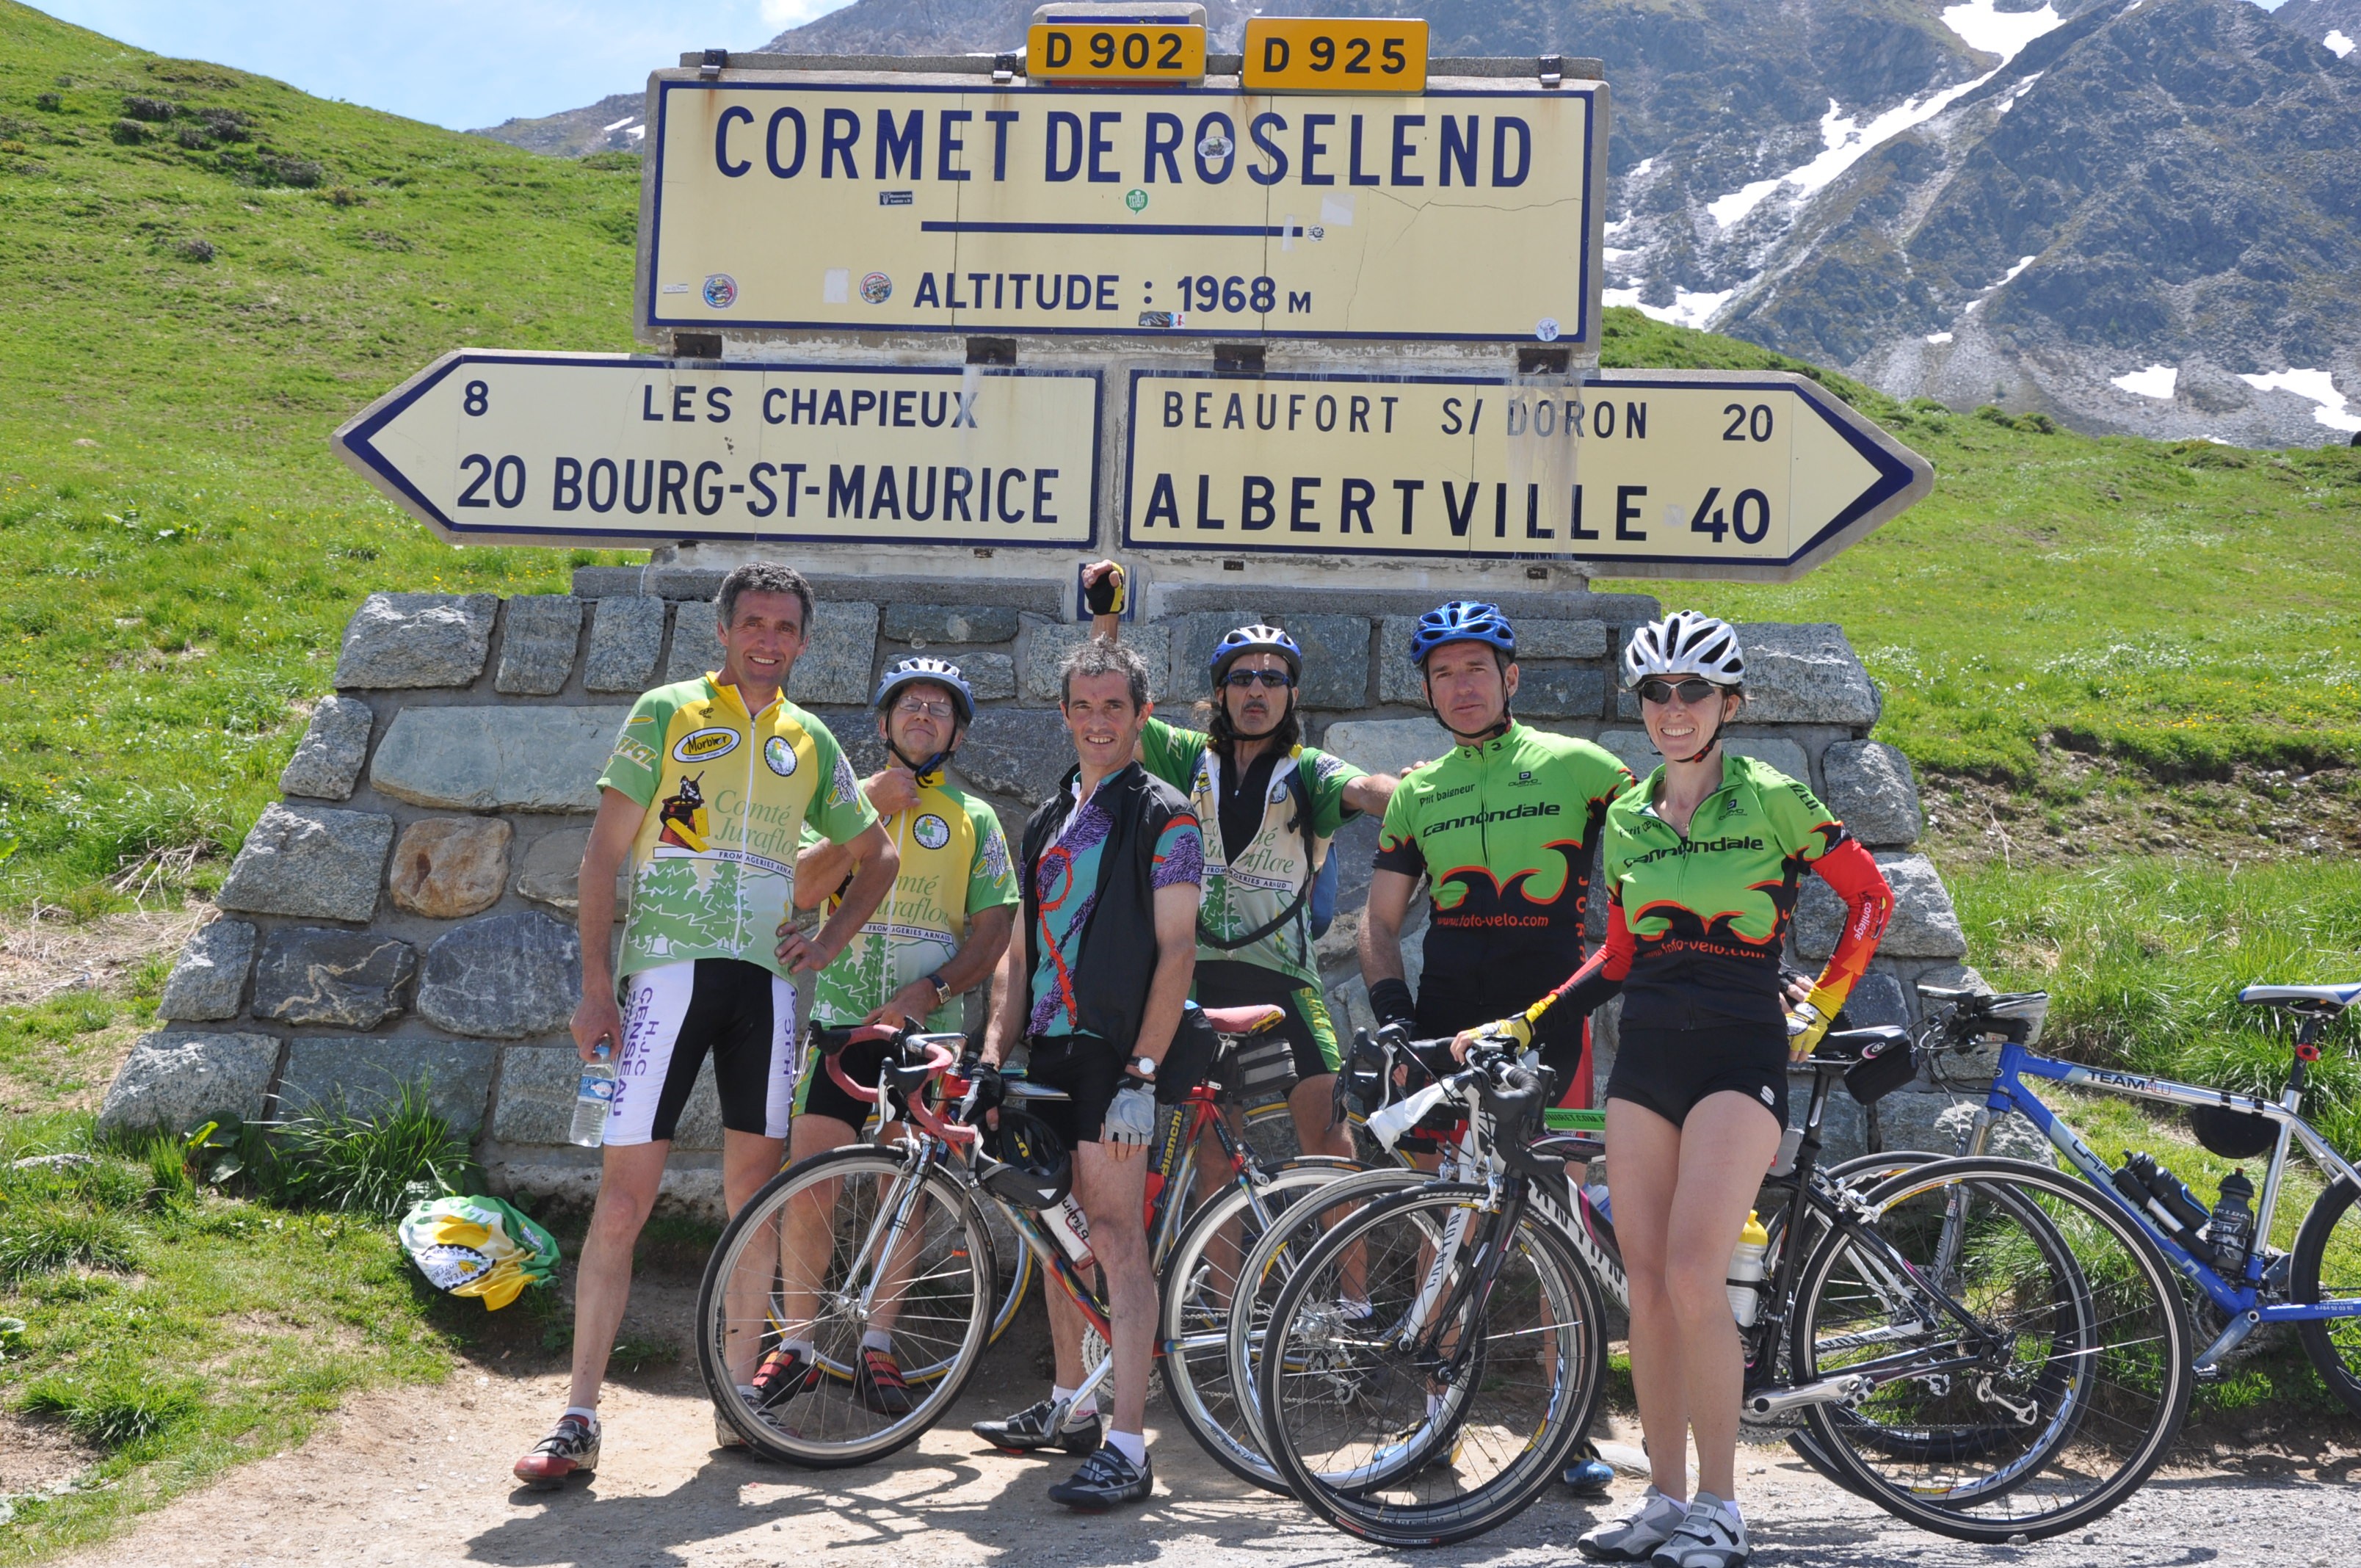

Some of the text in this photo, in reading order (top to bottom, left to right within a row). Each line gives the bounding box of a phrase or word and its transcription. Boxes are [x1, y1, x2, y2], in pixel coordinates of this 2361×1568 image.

[1045, 32, 1183, 69] D 902
[1263, 37, 1406, 75] D 925
[715, 105, 1531, 188] CORMET DE ROSELEND
[913, 272, 1120, 311] ALTITUDE
[1177, 275, 1276, 313] 1968
[1288, 291, 1311, 314] M
[463, 380, 979, 429] 8 LES CHAPIEUX
[1163, 391, 1774, 443] BEAUFORT S/ DORON 20
[457, 453, 1059, 526] 20 BOURG-ST-MAURICE
[1143, 472, 1771, 544] ALBERTVILLE 40
[714, 789, 792, 827] Comté
[1436, 783, 1476, 803] baigneur
[1422, 801, 1562, 839] cannondale
[1623, 835, 1765, 869] cannondale
[894, 874, 940, 896] mté
[1161, 1109, 1183, 1177] Bianchi
